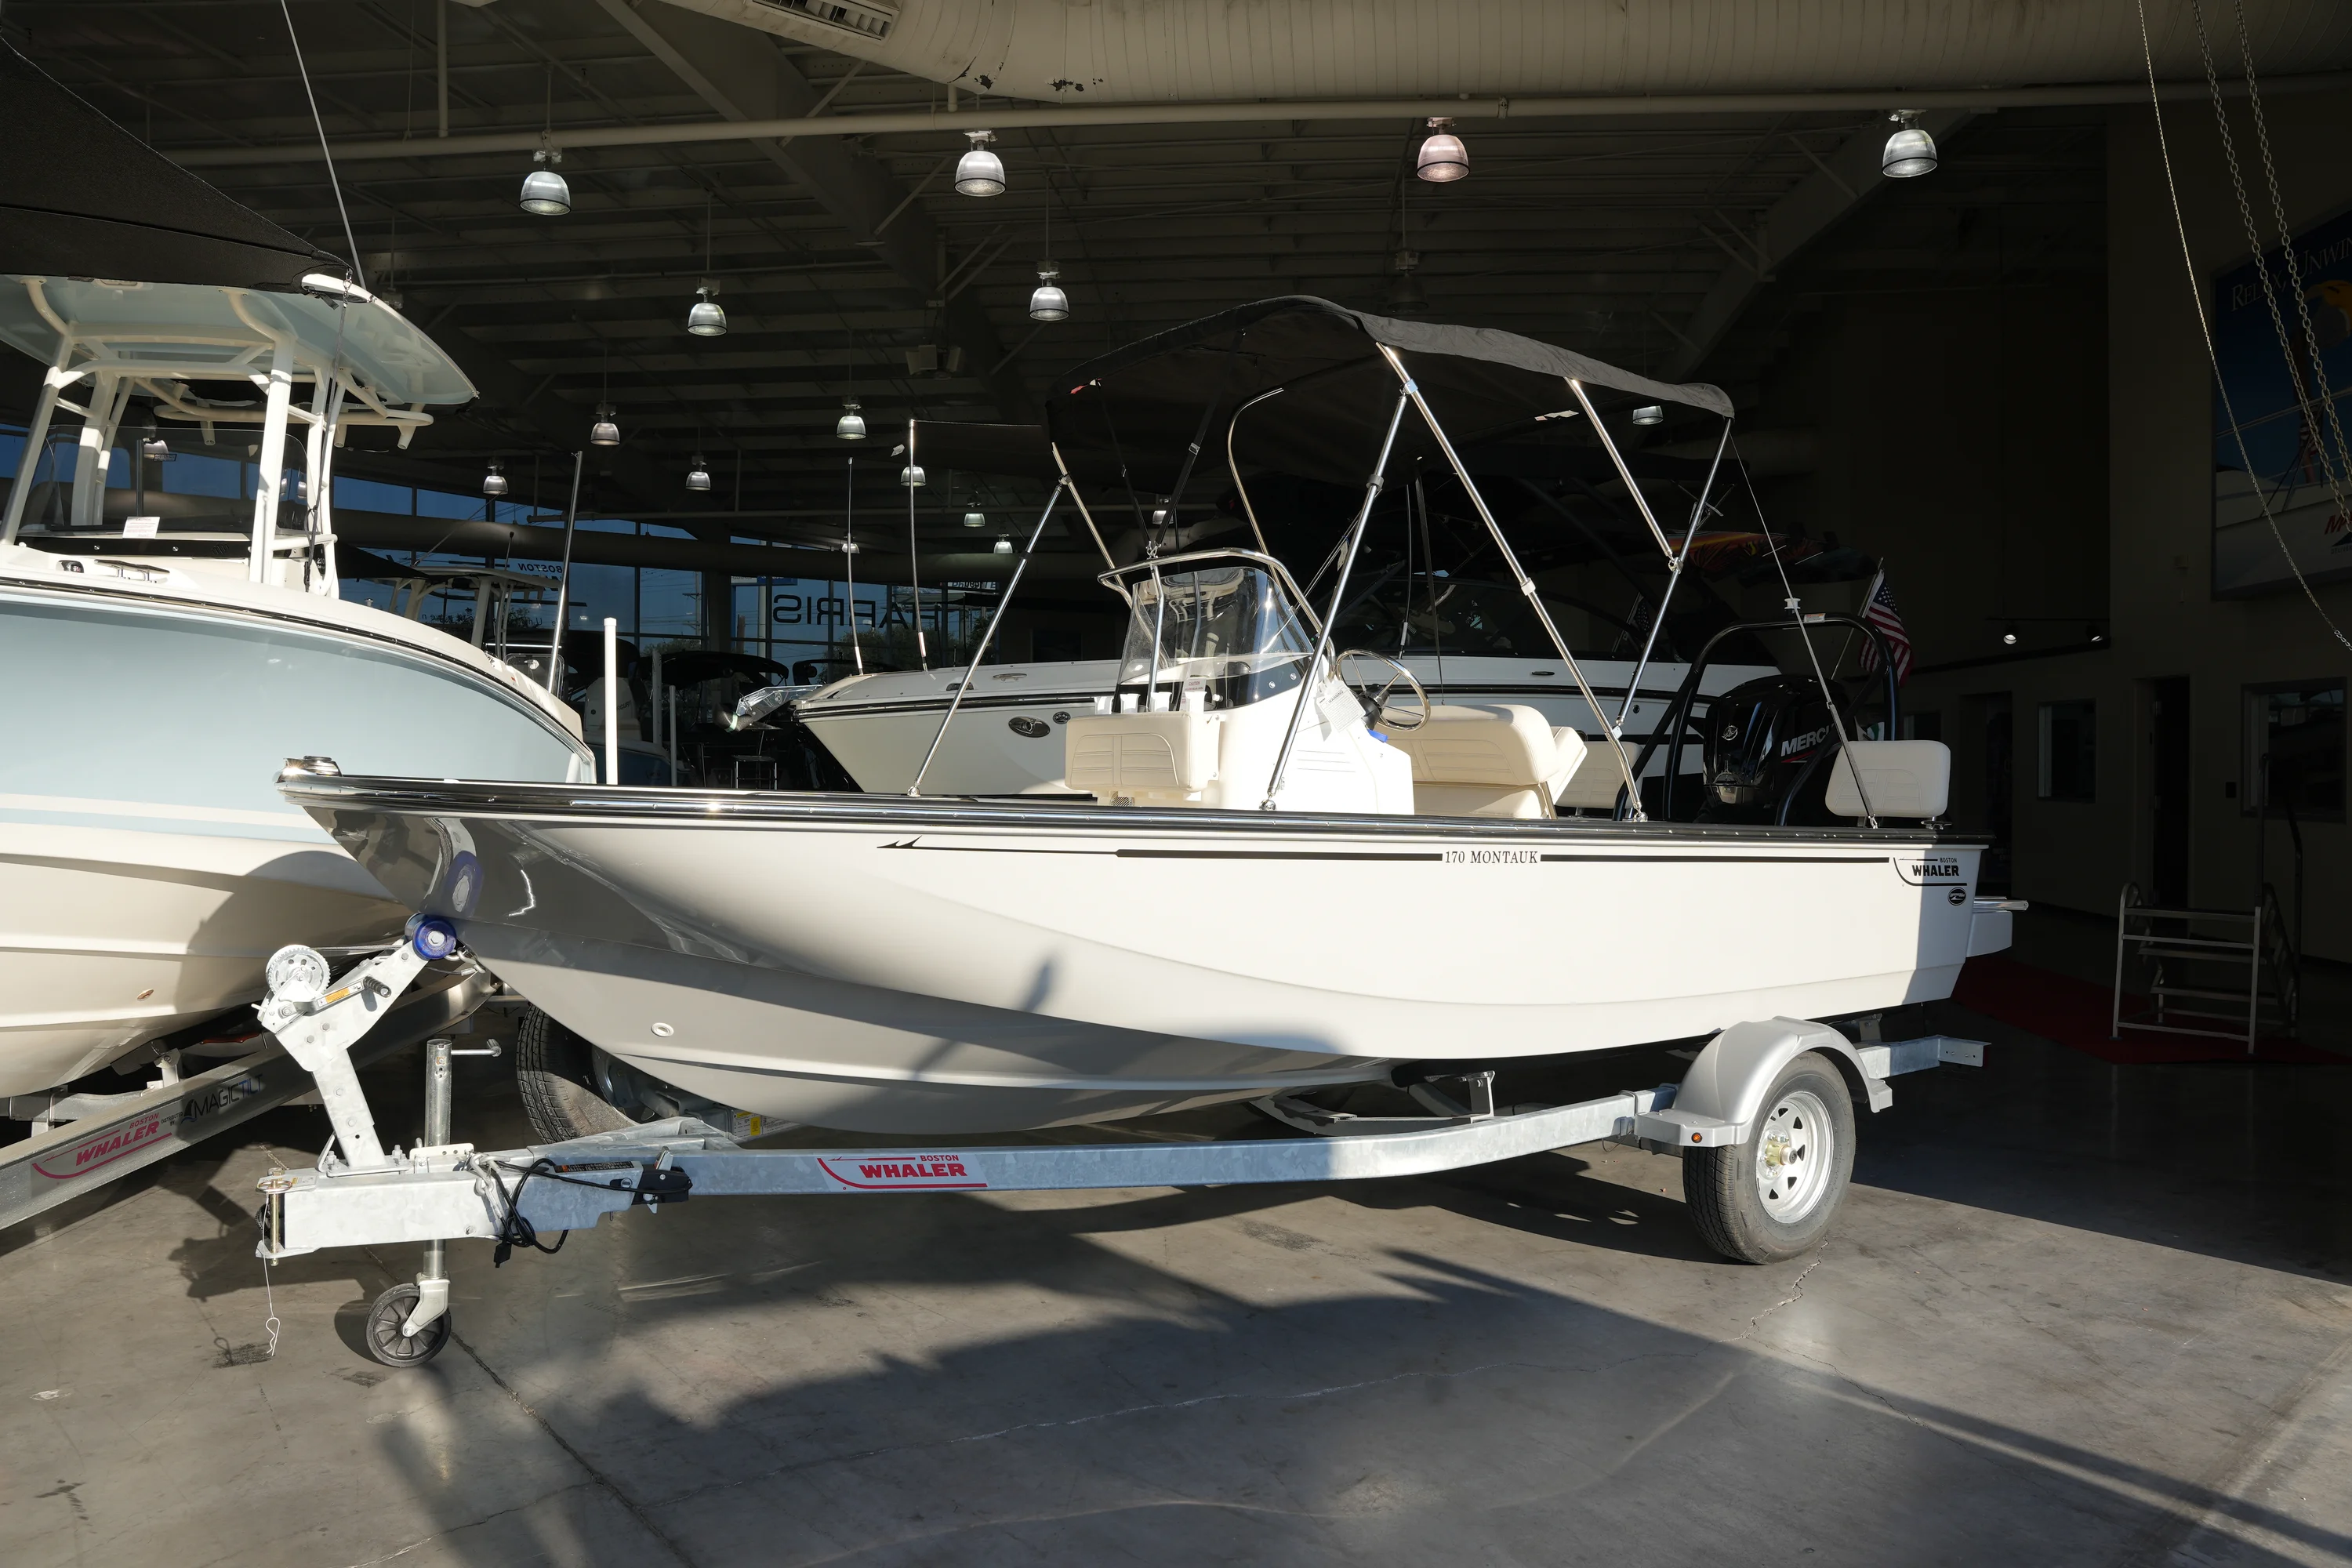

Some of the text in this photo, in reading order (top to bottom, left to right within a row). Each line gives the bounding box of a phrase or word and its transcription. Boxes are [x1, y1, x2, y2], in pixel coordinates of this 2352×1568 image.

[2230, 270, 2287, 312] RELX,
[1781, 722, 1835, 757] MERC
[1446, 851, 1538, 864] 170 MONTAUK
[1911, 865, 1960, 877] WHALER
[194, 1073, 263, 1116] MAGICTILT
[129, 1113, 159, 1129] BOSTON
[161, 1111, 183, 1124] DISTRIBUTED
[76, 1121, 160, 1167] WHALER
[858, 1163, 967, 1178] WHALER
